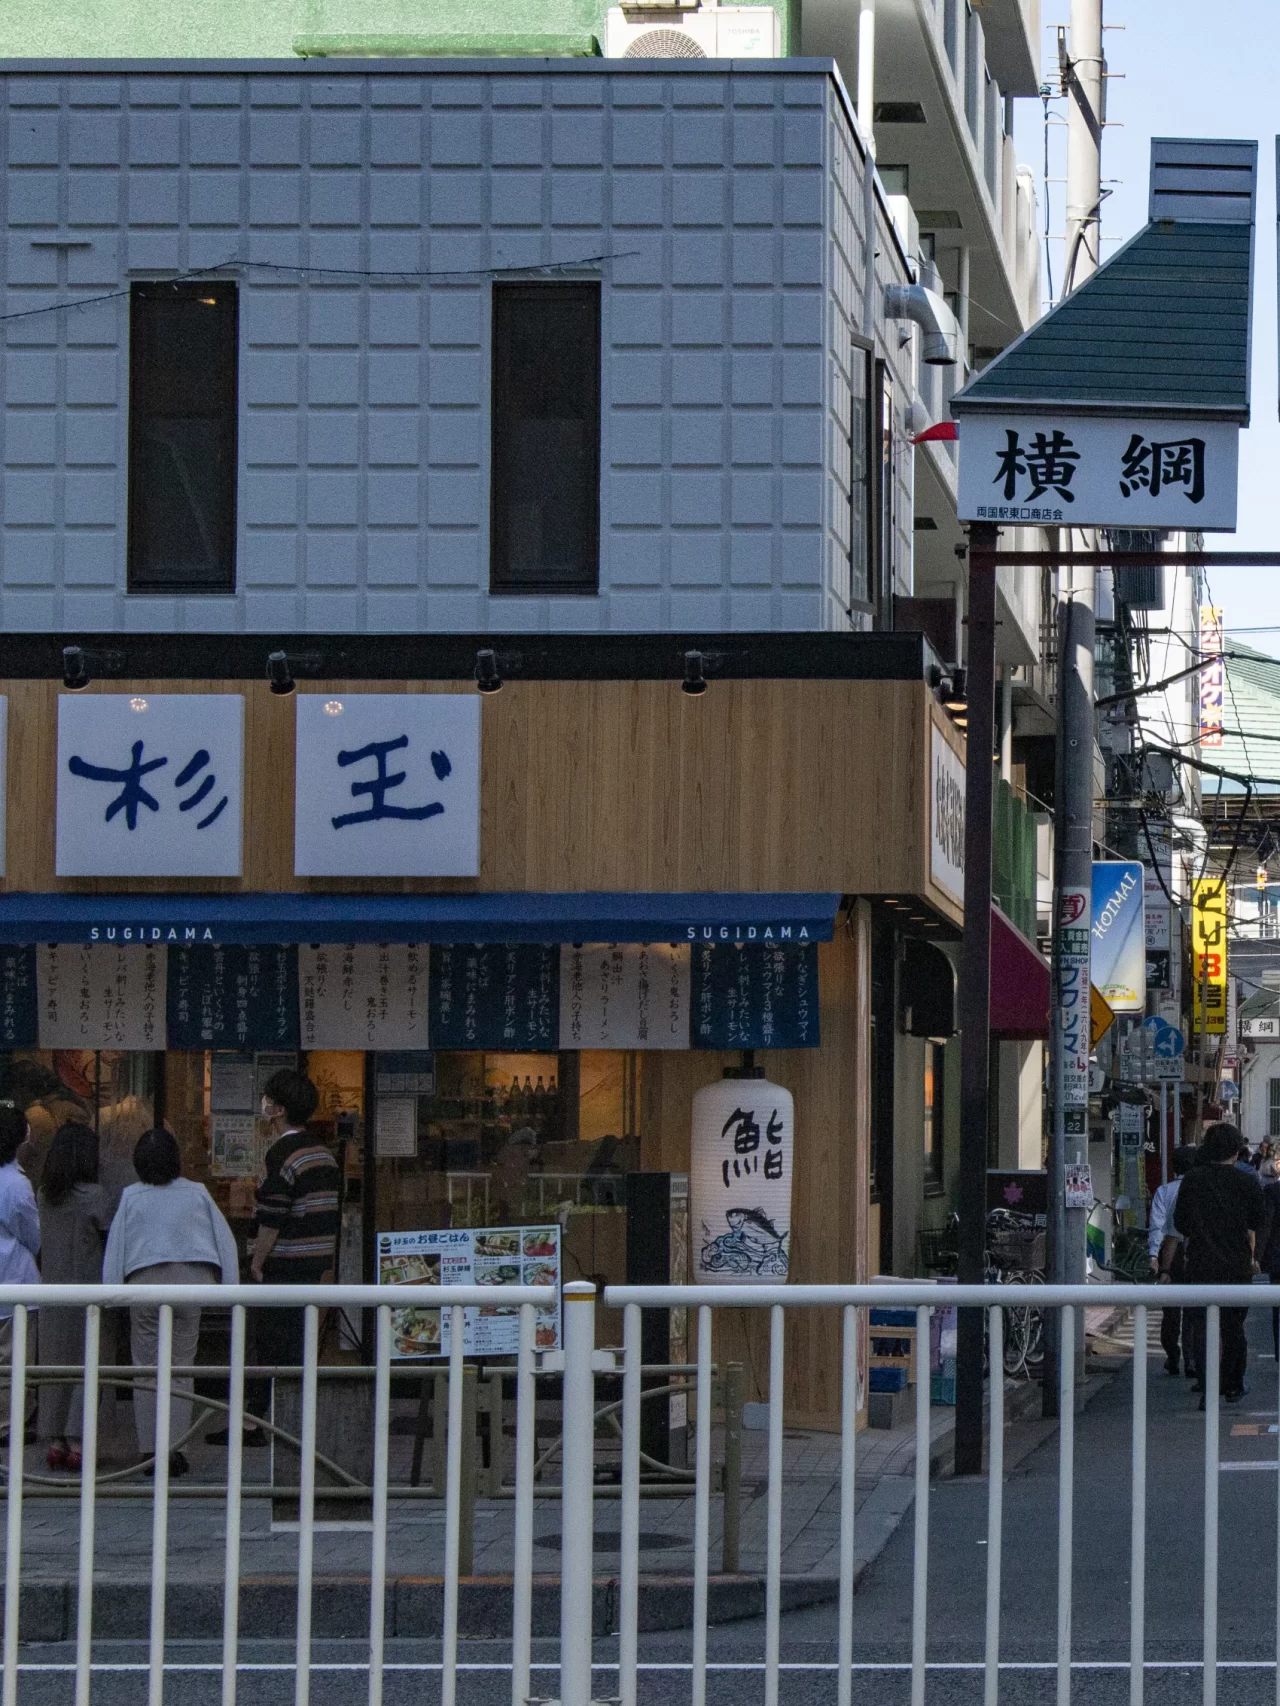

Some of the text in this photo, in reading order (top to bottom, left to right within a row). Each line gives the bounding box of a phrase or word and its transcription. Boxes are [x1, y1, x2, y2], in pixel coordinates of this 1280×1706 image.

[995, 429, 1207, 504] 横綱
[977, 506, 1064, 521] 両国駅東口商店会
[69, 740, 228, 831] 杉
[331, 735, 452, 829] 玉
[91, 927, 214, 940] SUGIDAMA
[687, 926, 809, 939] SUGIDAMA
[46, 951, 58, 1023] キャビア寿司
[79, 952, 91, 1035] いくら鬼おろし
[178, 951, 190, 1023] キャビア寿司
[343, 951, 354, 1012] 海鮮赤だし
[407, 951, 419, 1031] 飲めるサーモン
[600, 959, 611, 1041] あさりラーメン
[670, 953, 681, 1034] いくら鬼おろし
[738, 952, 750, 1042] レバ刺しみたいな
[772, 951, 785, 997] 欲張りな
[796, 950, 809, 1041] うなぎシュウマイ
[103, 986, 114, 1043] 生サーモン
[366, 995, 378, 1043] 鬼おろし
[527, 988, 539, 1042] 生サーモン
[726, 986, 738, 1042] 生サーモン
[1067, 1122, 1081, 1131] 22
